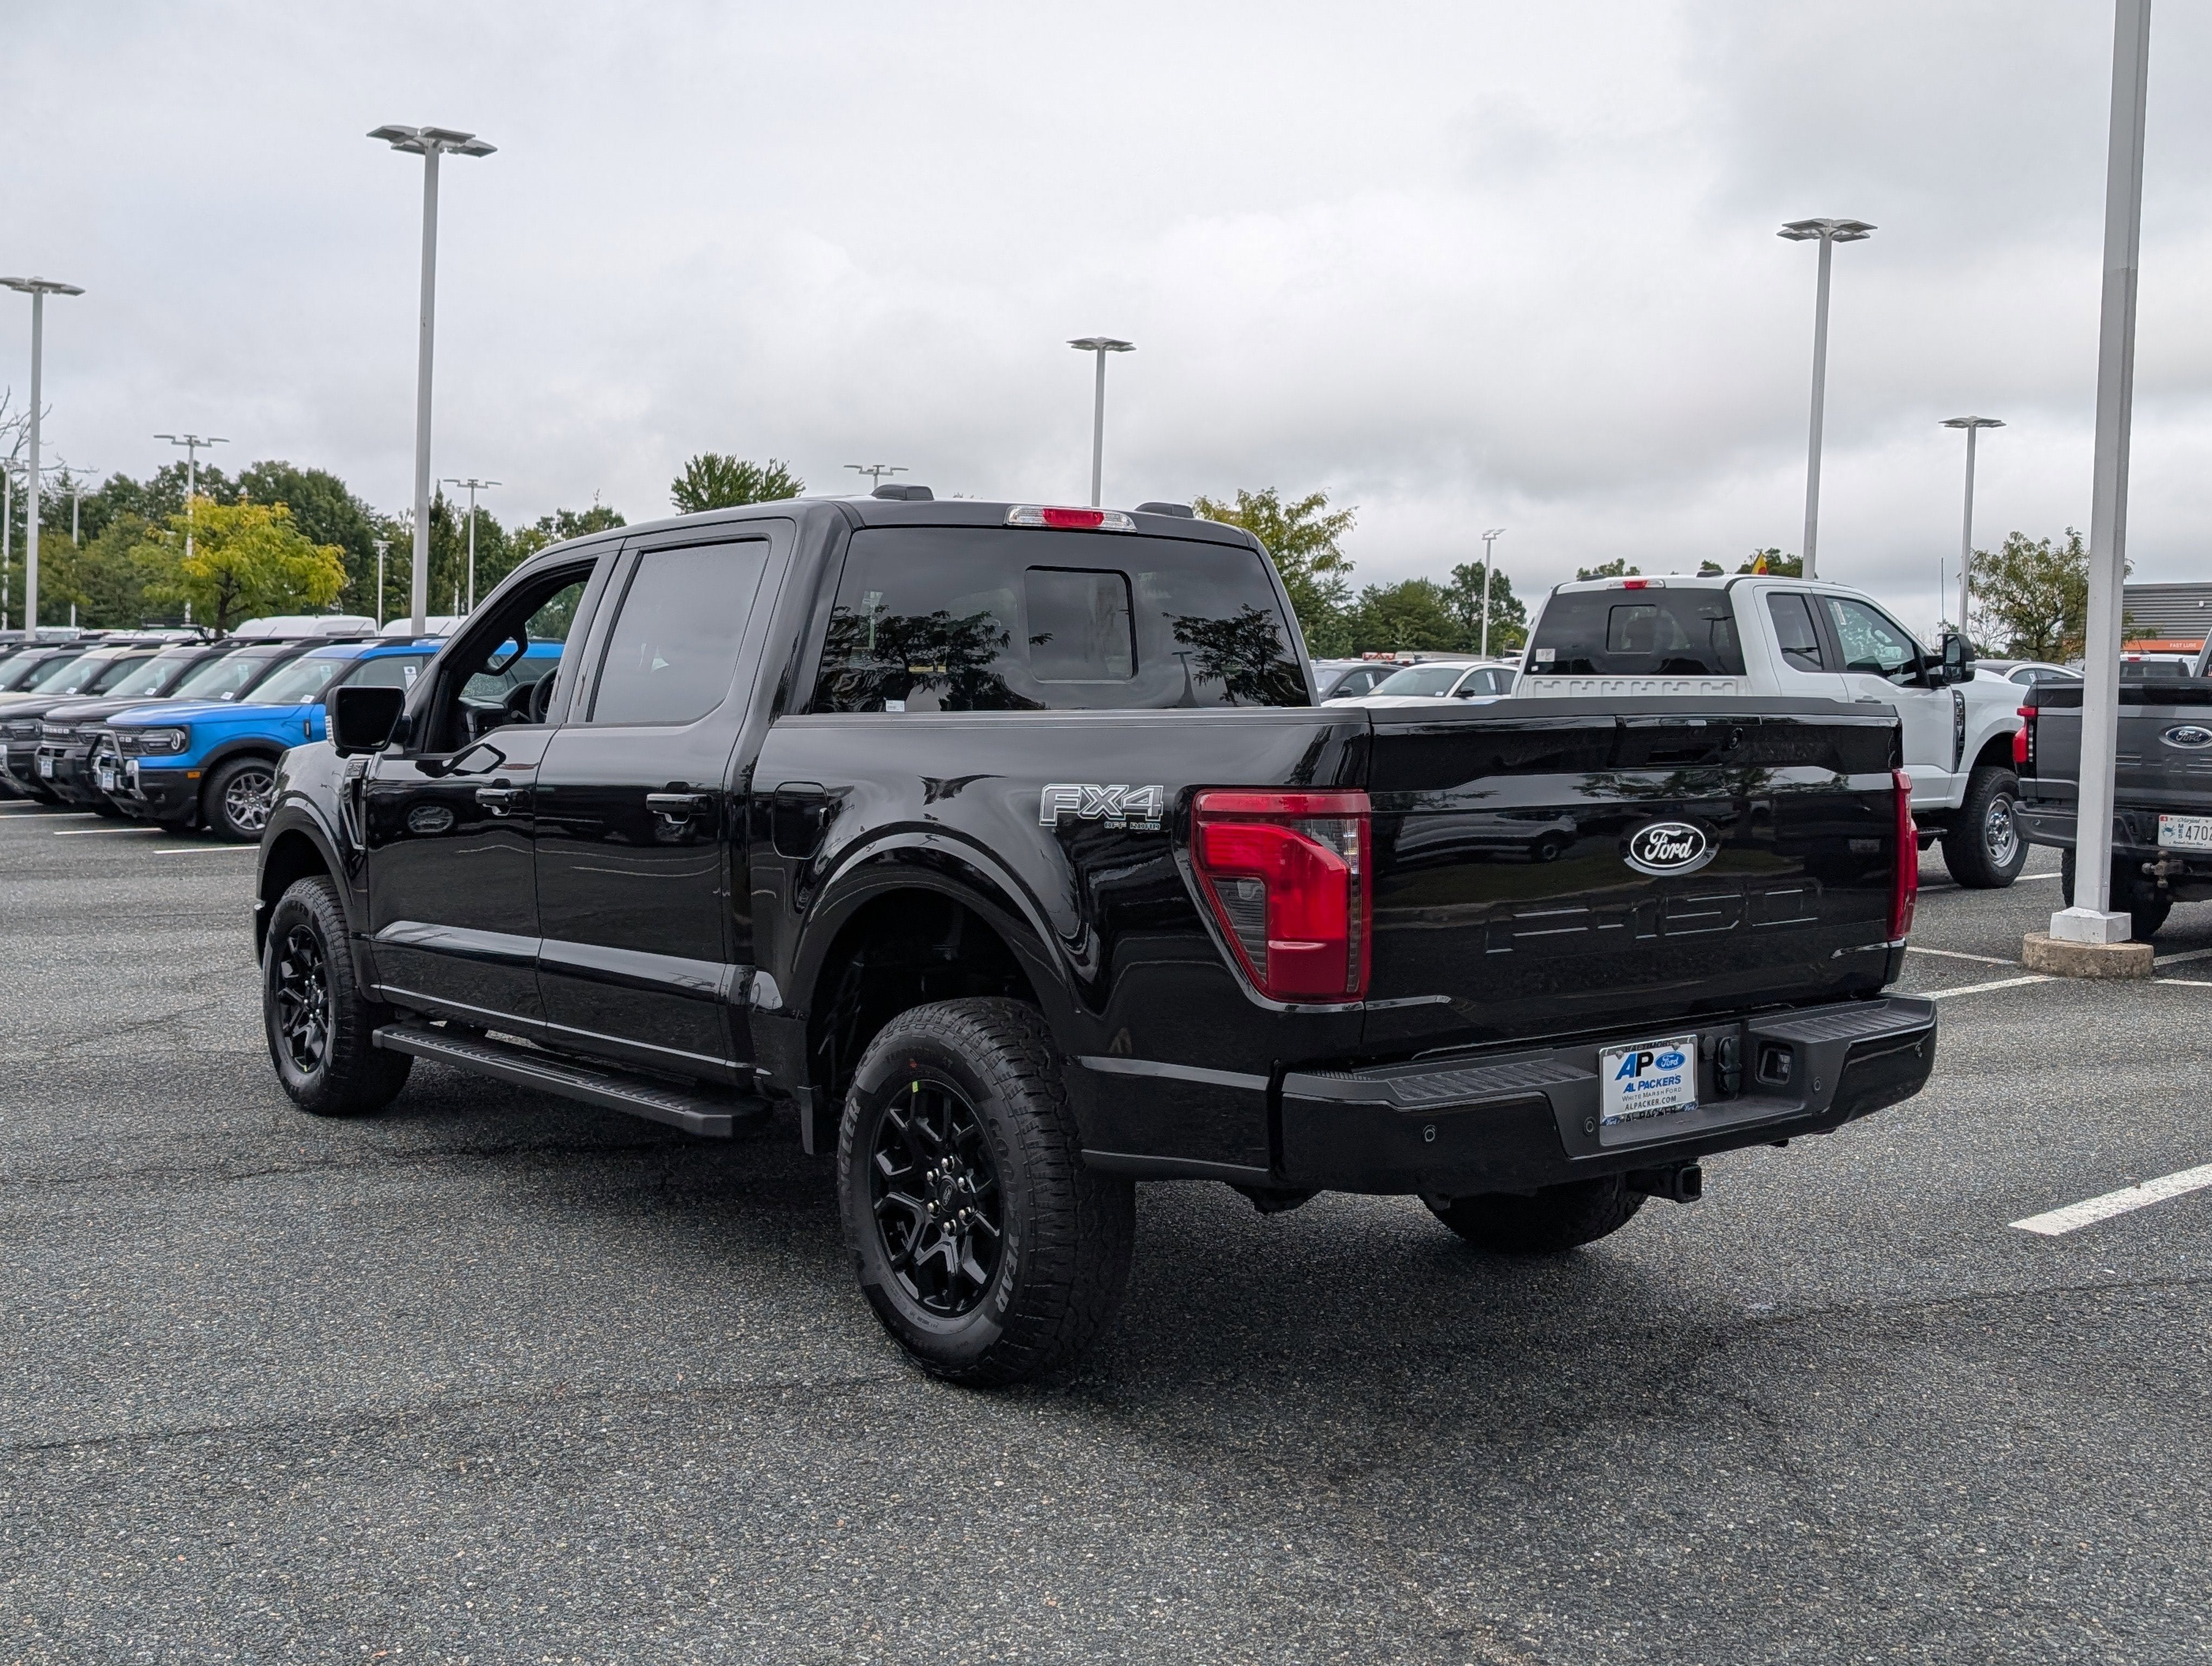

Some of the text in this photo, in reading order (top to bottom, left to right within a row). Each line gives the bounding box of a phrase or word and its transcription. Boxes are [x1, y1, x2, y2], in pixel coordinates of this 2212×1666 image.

[2176, 730, 2202, 742] Ford
[1039, 784, 1164, 826] FX4
[1104, 821, 1161, 830] OFF ROAD
[1644, 829, 1693, 861] Ford
[1615, 1052, 1679, 1081] AP Ford
[1623, 1074, 1681, 1093] AL PACKER'S
[1625, 1095, 1676, 1110] ALPACKER.COM
